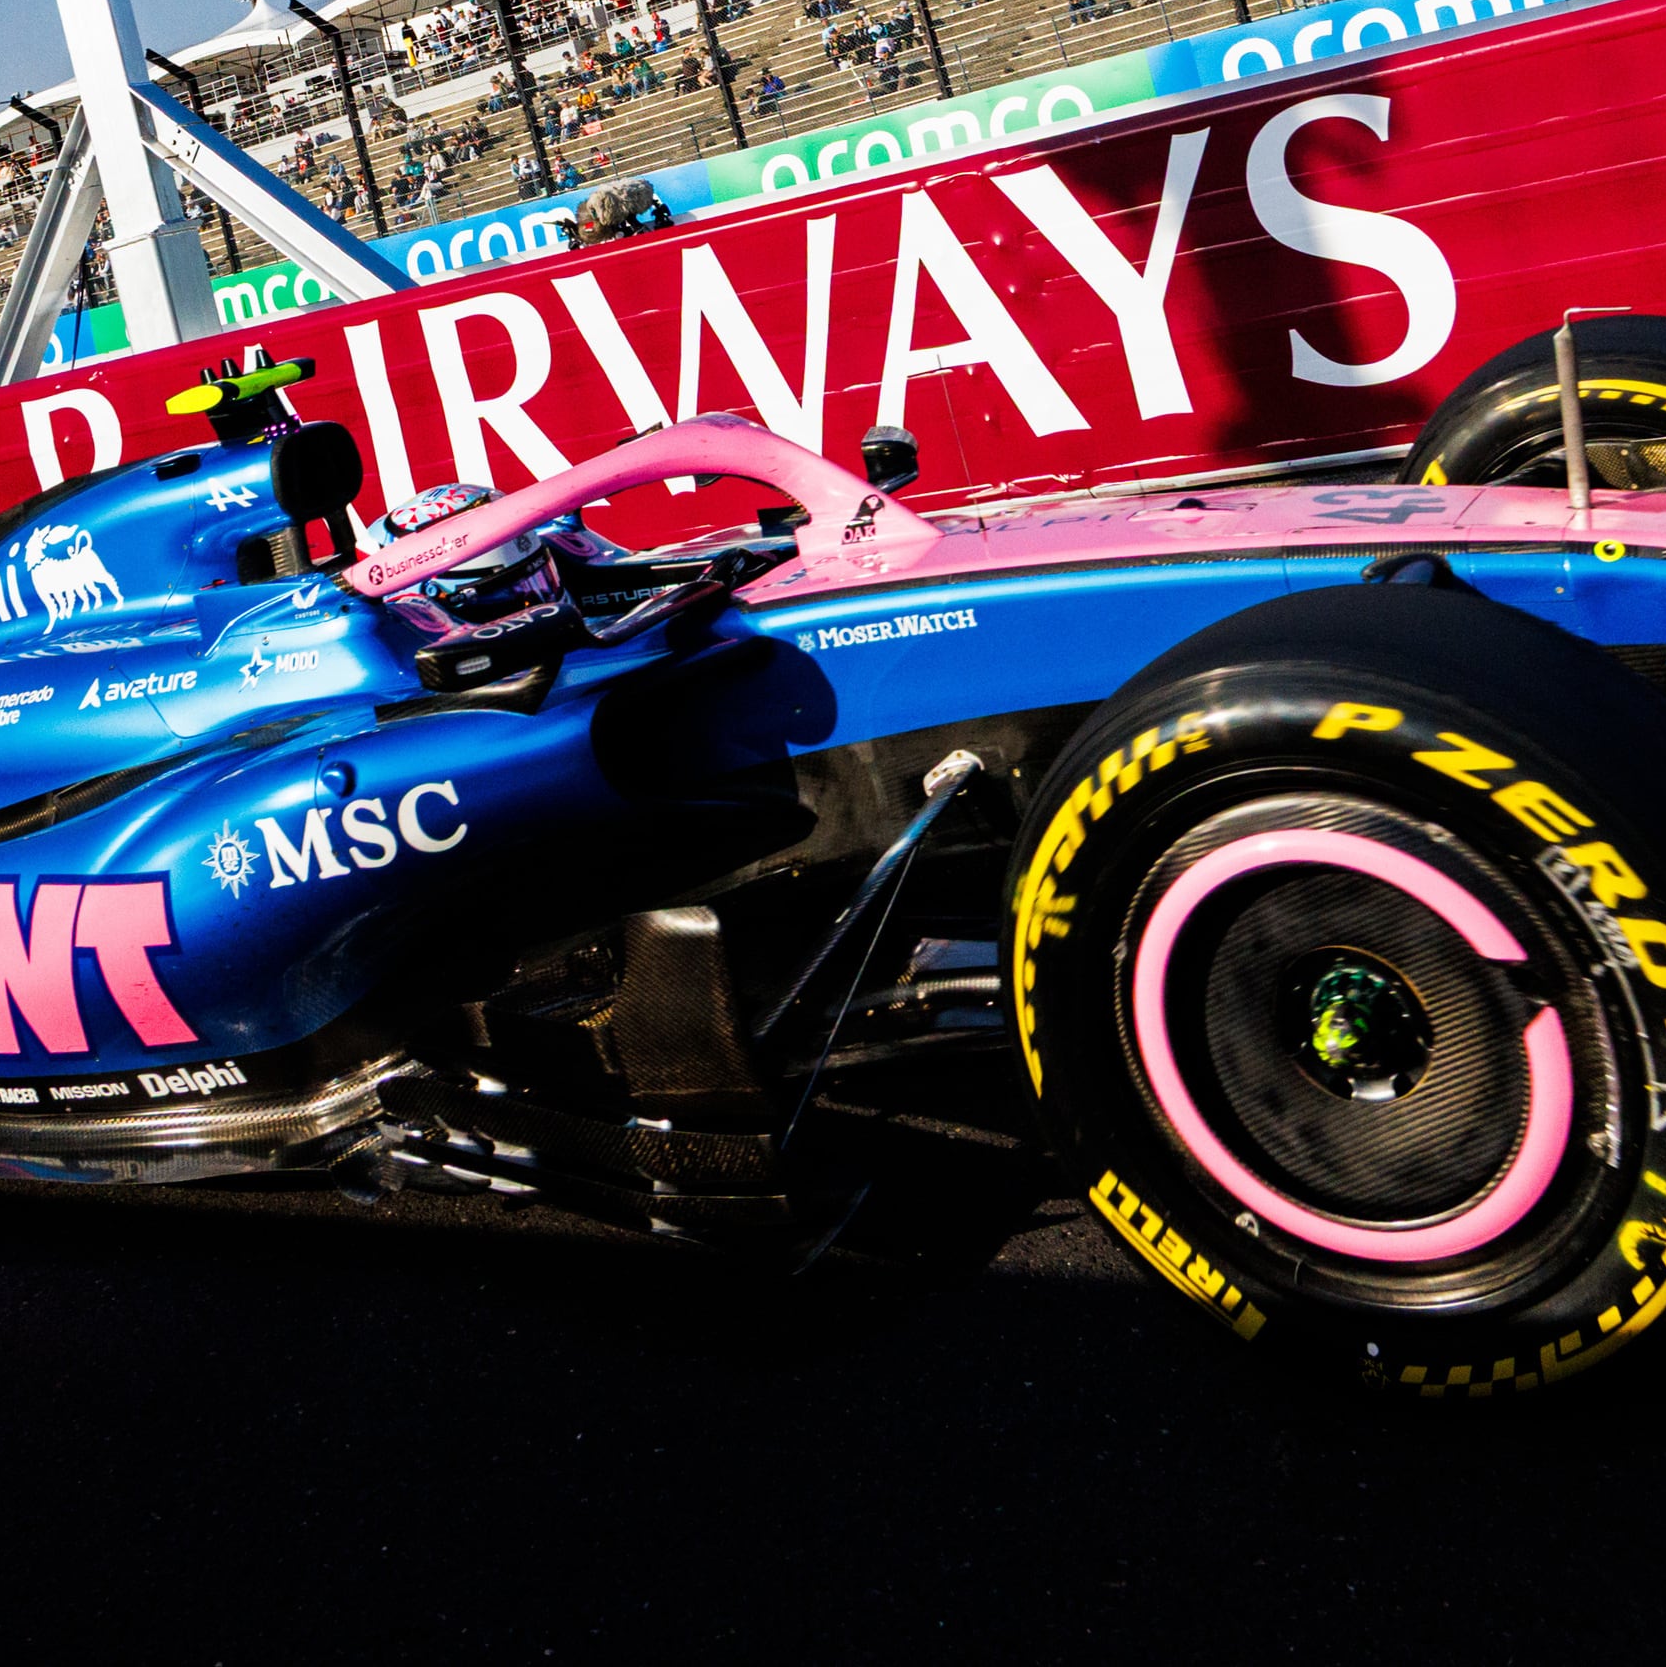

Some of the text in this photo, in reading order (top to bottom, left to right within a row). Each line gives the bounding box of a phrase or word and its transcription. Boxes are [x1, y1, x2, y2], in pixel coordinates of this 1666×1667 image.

[817, 608, 978, 650] MOSER.WATCH
[274, 650, 320, 675] MODO
[1312, 701, 1404, 740] P
[254, 780, 469, 889] MSC
[0, 1086, 40, 1104] RACER
[49, 1082, 130, 1101] MISSION
[137, 1060, 249, 1099] Delphi
[1089, 1169, 1268, 1341] PIRELLI
